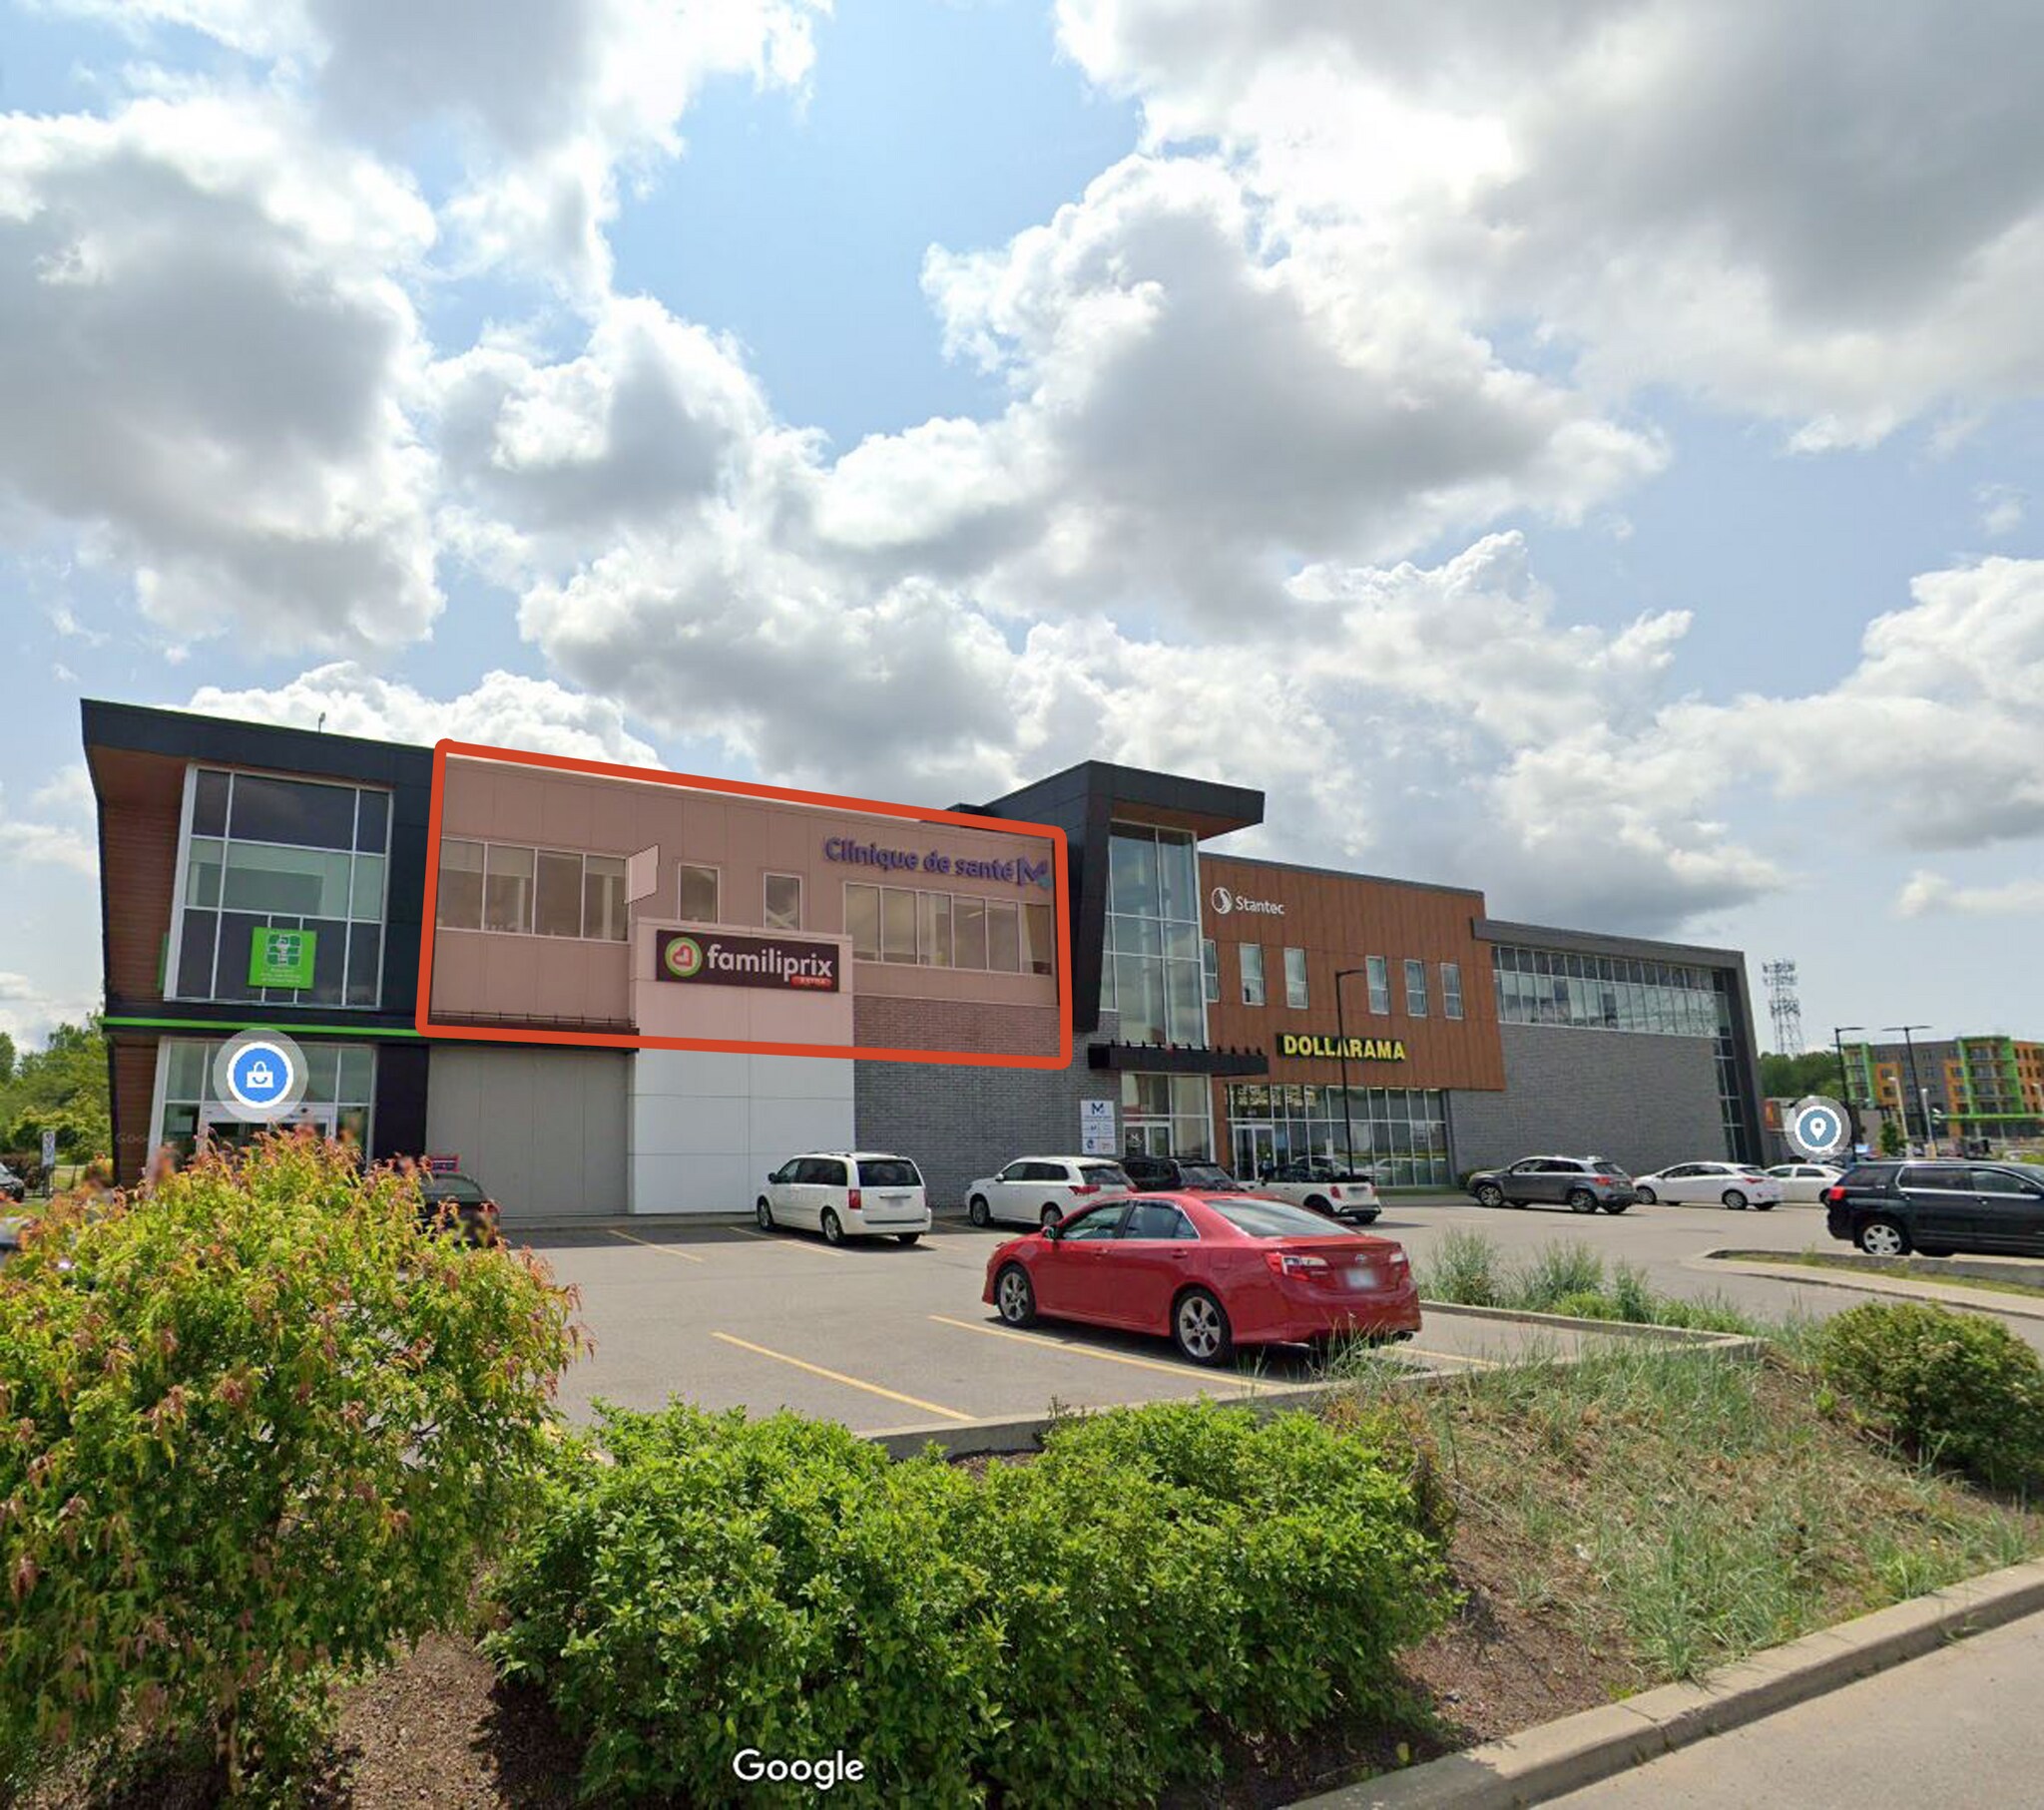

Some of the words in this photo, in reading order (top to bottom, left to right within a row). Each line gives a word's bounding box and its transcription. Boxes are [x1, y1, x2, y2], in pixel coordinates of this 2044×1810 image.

[825, 837, 918, 871] Clinique
[924, 849, 950, 873] de
[955, 855, 1013, 882] santé
[1236, 895, 1284, 915] Stantec
[707, 943, 832, 982] familiprix
[1282, 1035, 1405, 1060] DOLLARAMA
